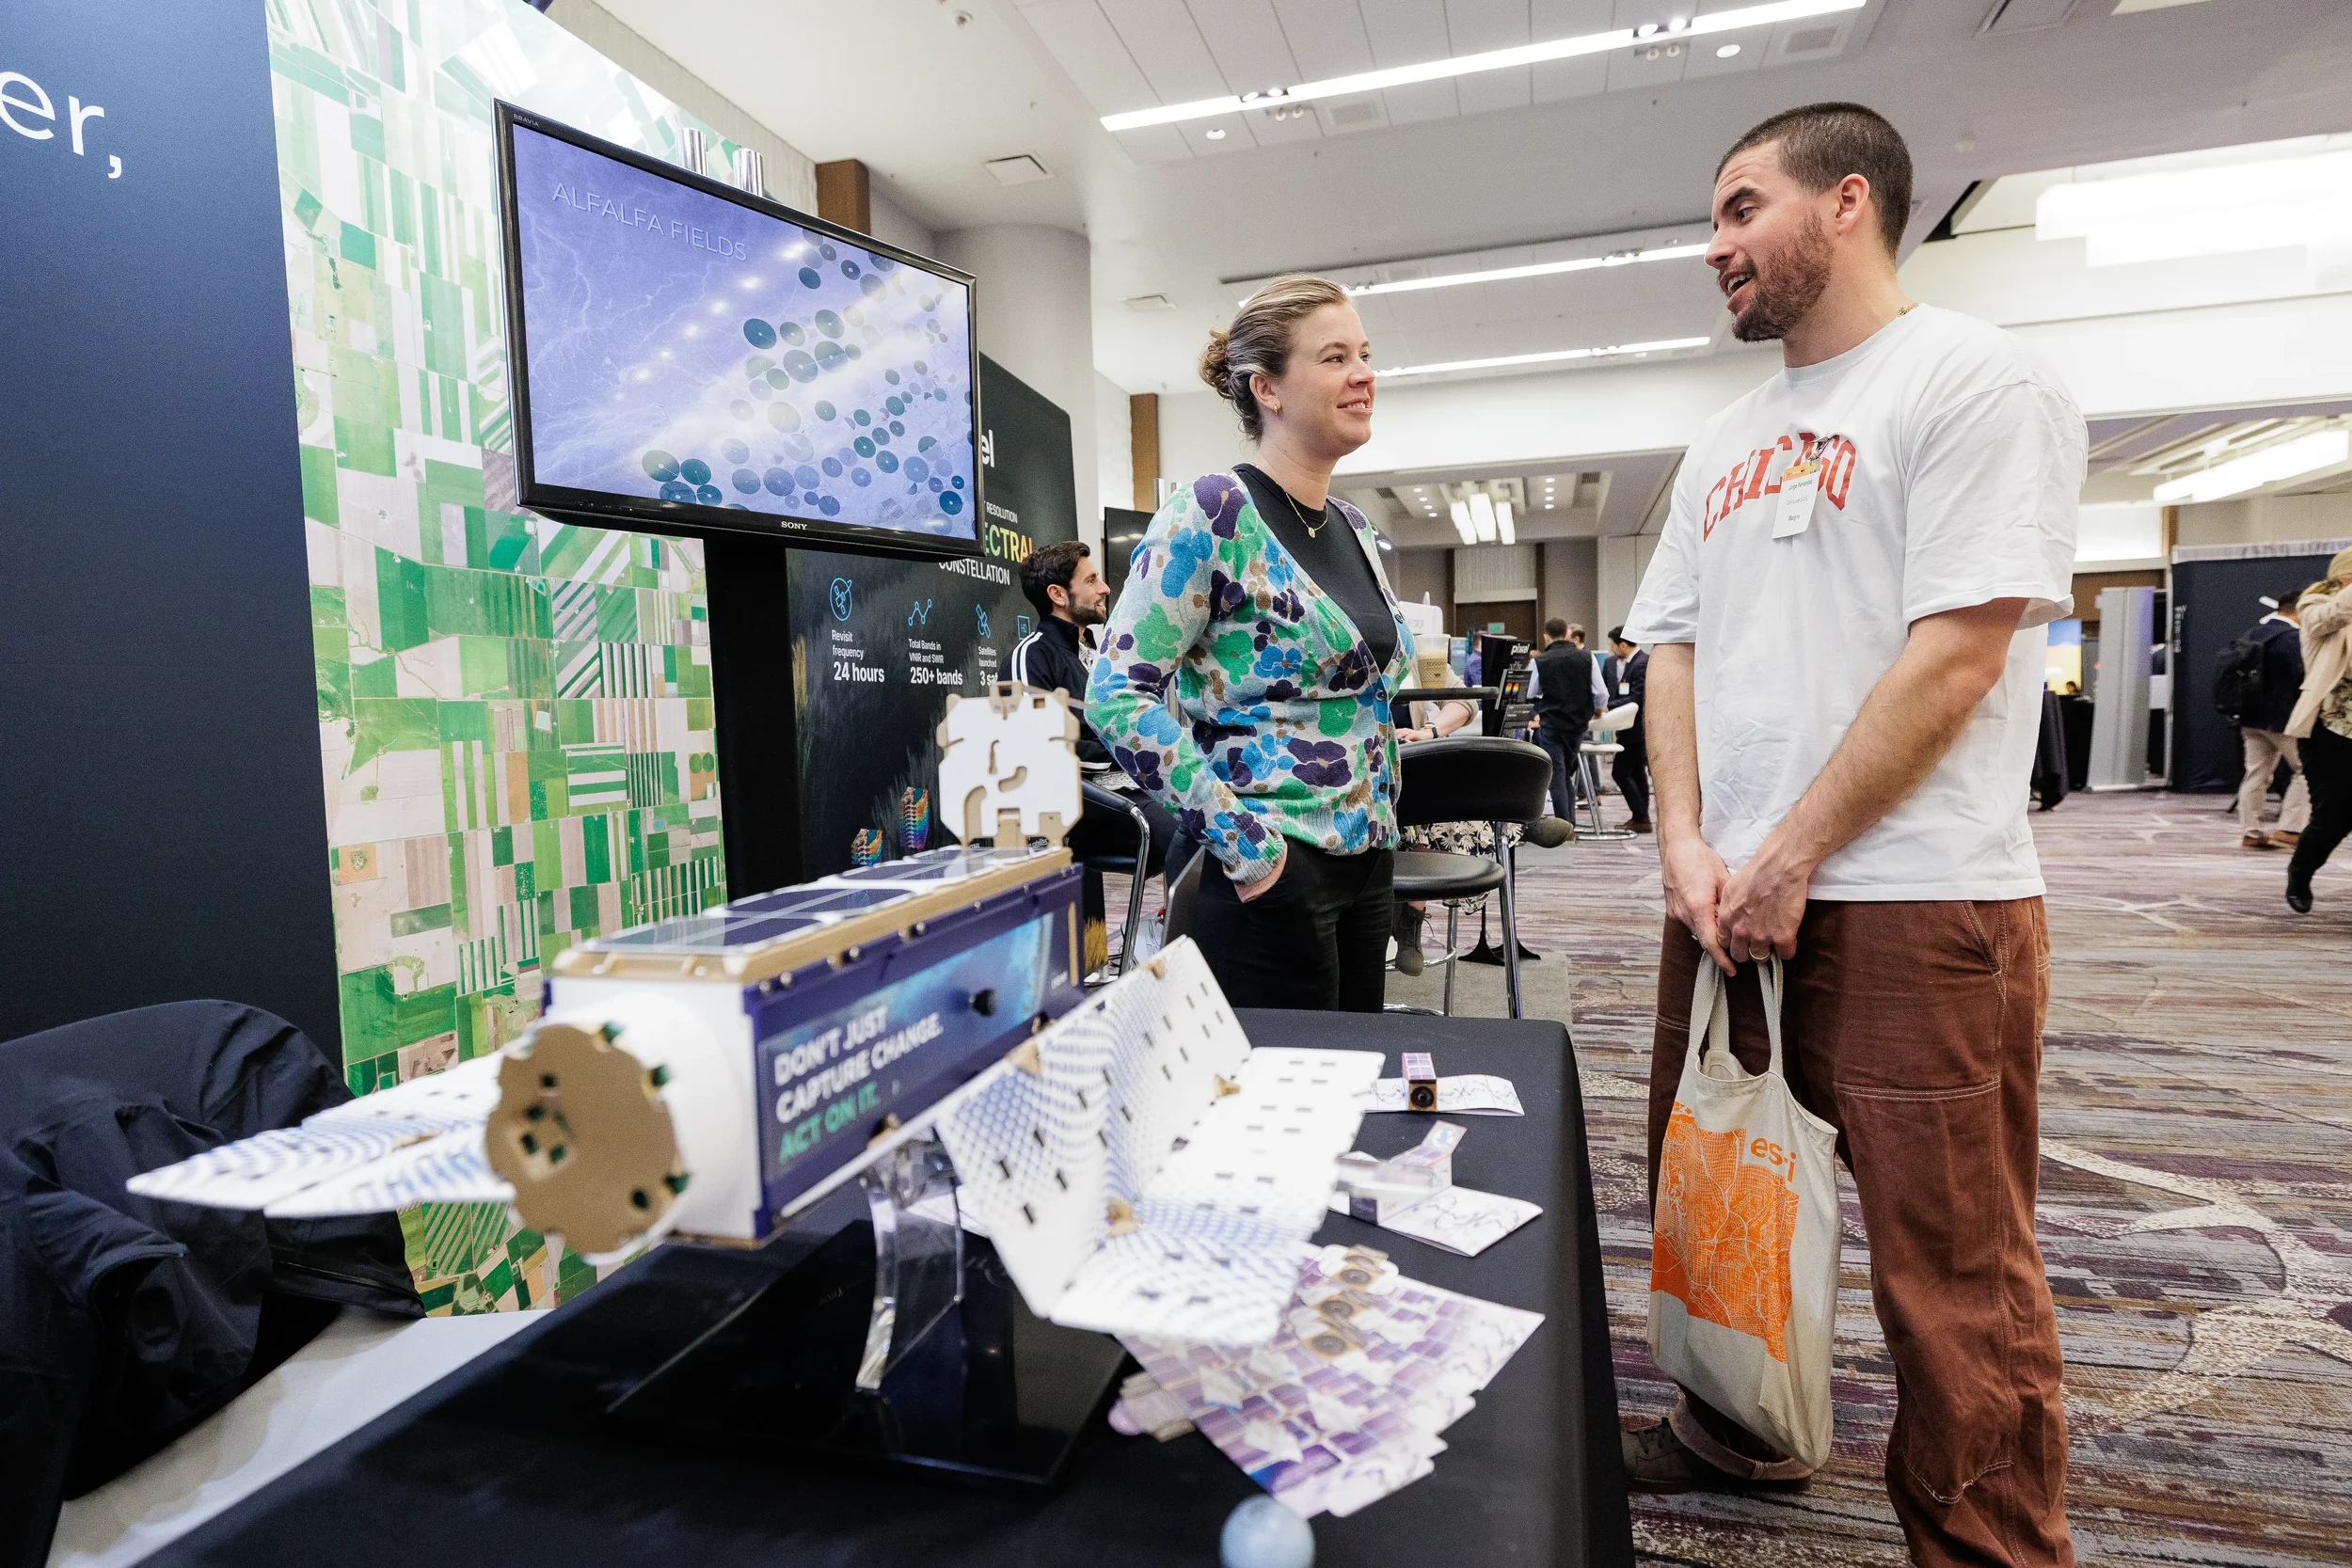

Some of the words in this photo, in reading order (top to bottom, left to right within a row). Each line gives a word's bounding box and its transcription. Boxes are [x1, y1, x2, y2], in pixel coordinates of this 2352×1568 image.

[0, 71, 122, 179] er,
[513, 113, 539, 127] BRAVIA
[551, 182, 664, 236] ALFALFA
[670, 219, 747, 261] FIELDS
[986, 501, 1018, 524] RESOLUTION
[781, 521, 807, 531] SONY
[832, 629, 853, 642] Revisit
[832, 644, 865, 660] frequency
[909, 639, 921, 649] Total
[922, 640, 936, 651] Bands
[936, 641, 942, 651] in
[978, 646, 996, 657] Satellites
[1511, 643, 1531, 656] pixel
[909, 652, 922, 662] VNIR
[922, 654, 931, 663] and
[931, 655, 945, 664] SWIR
[978, 658, 997, 668] launched
[834, 661, 850, 681] 24
[851, 662, 885, 683] hours
[910, 666, 935, 685] 250+
[936, 668, 963, 686] bands
[979, 670, 986, 687] 3
[773, 1026, 843, 1087] DON'T
[842, 1005, 889, 1051] JUST
[775, 1049, 871, 1124] CAPTURE
[870, 1011, 945, 1070] CHANGE.
[779, 1113, 823, 1164] ACT
[824, 1097, 857, 1132] ON
[1750, 1137, 1797, 1183] esi
